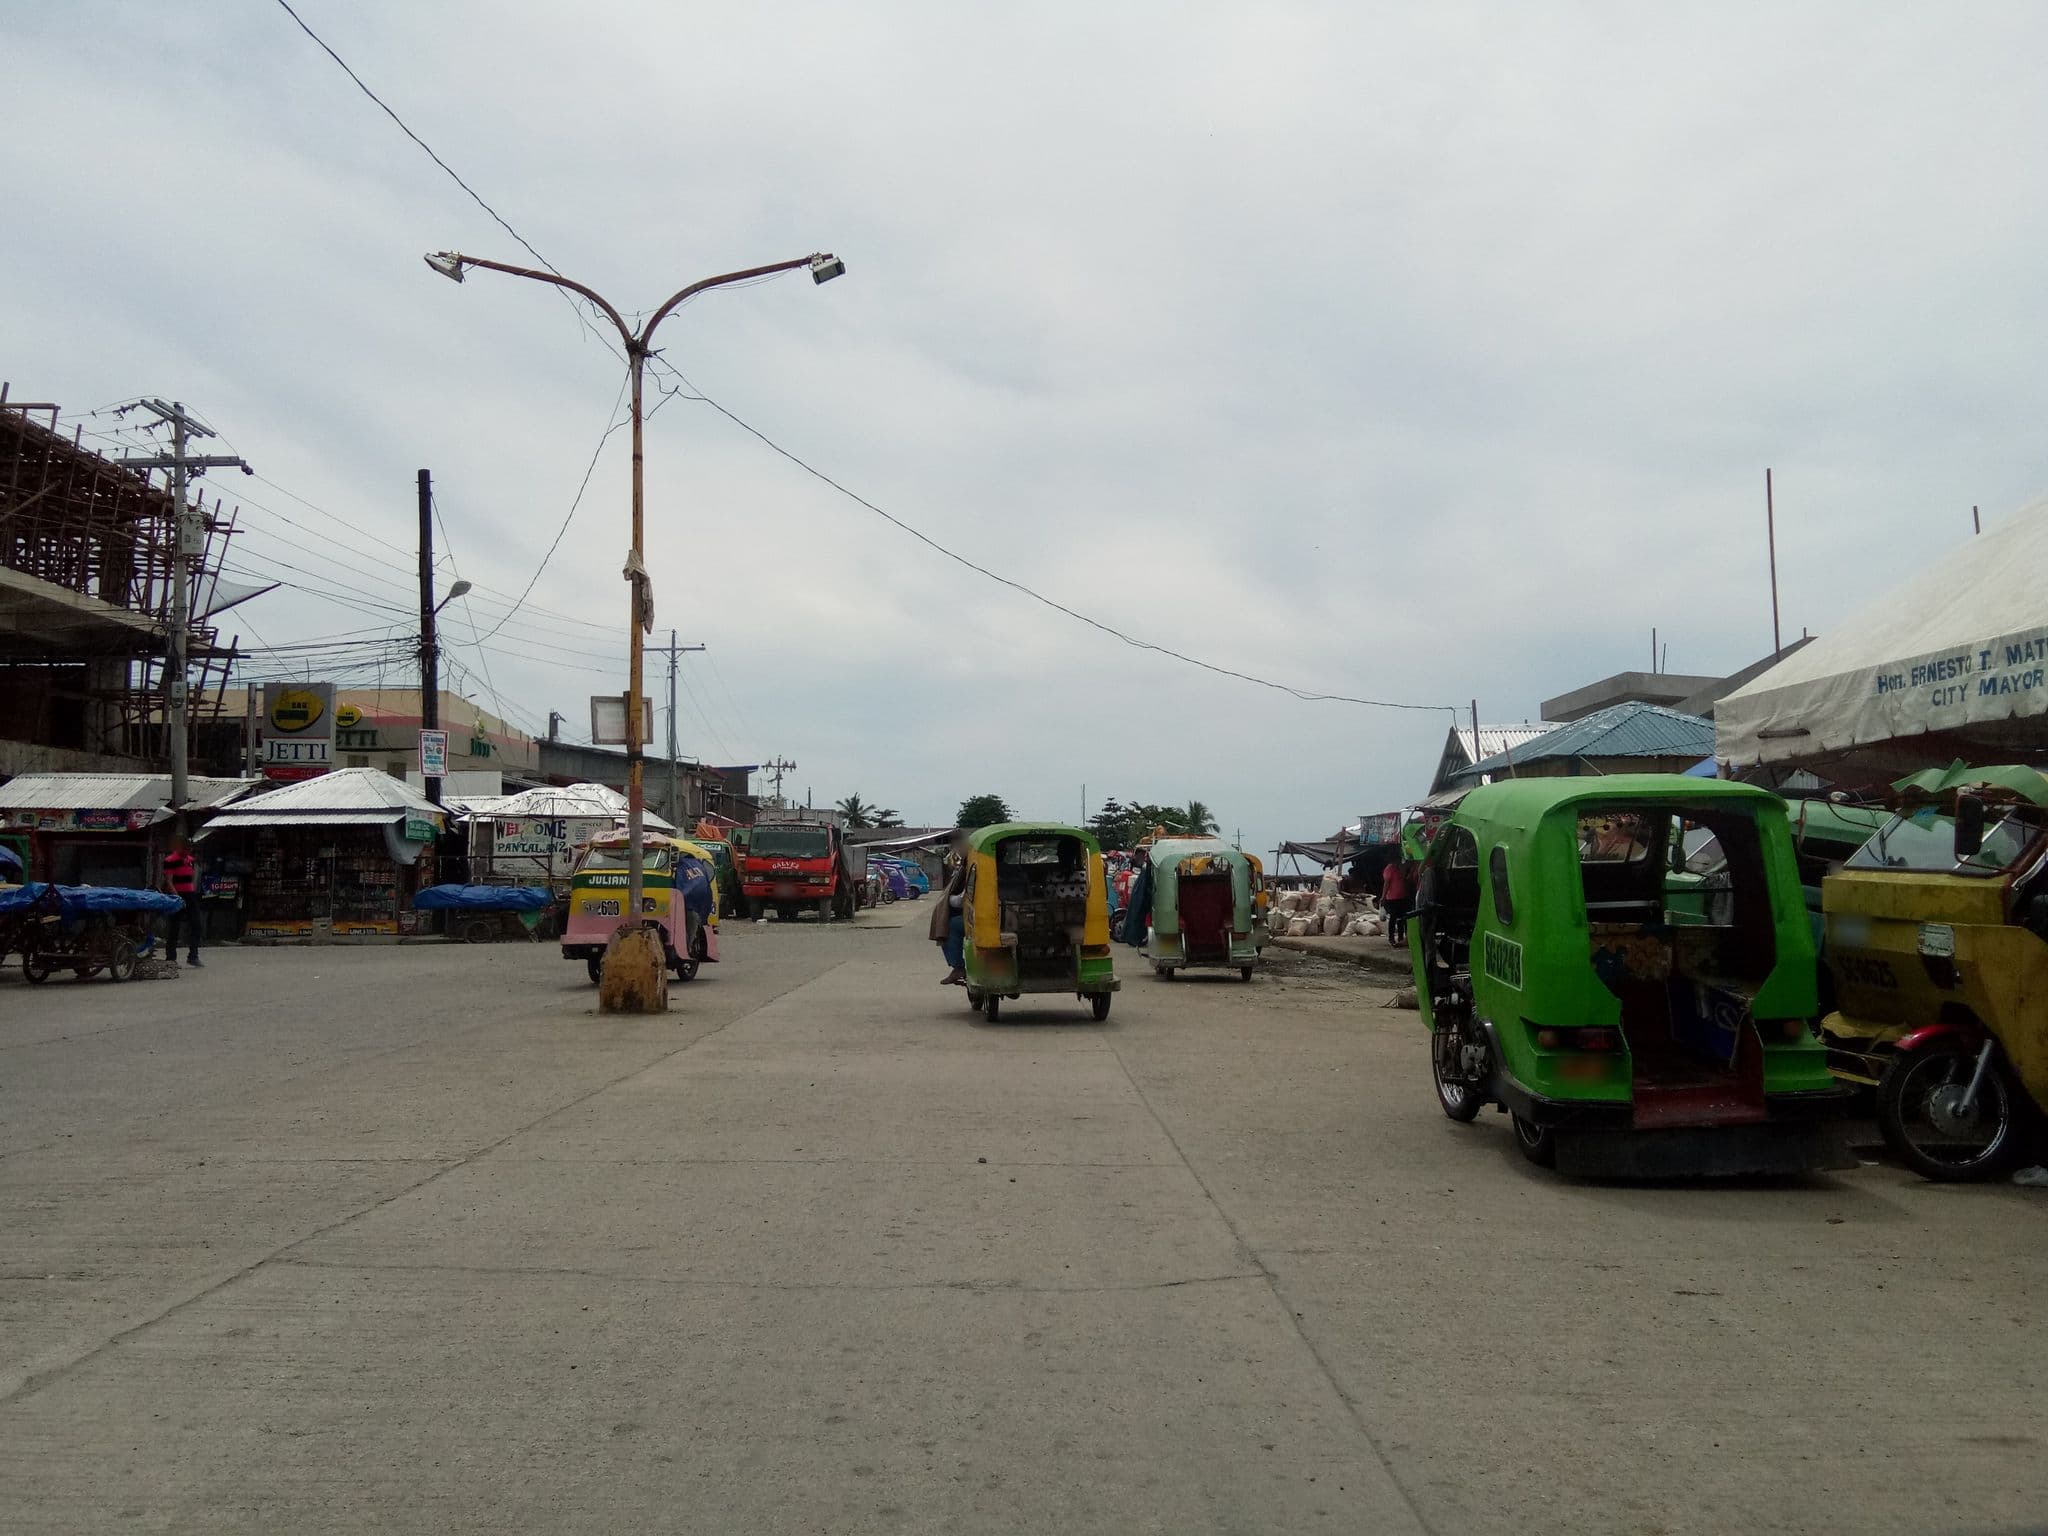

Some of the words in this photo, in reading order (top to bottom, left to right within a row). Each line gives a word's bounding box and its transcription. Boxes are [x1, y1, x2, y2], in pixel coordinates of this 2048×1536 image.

[1911, 655, 1972, 688] ERNESTO
[1979, 650, 1992, 671] T.
[2005, 637, 2048, 667] MAT
[1932, 683, 1969, 706] CITY
[1978, 669, 2044, 697] MAYOR
[267, 741, 328, 761] JETTI
[495, 820, 567, 840] WELCOME
[589, 876, 630, 885] JULIAN
